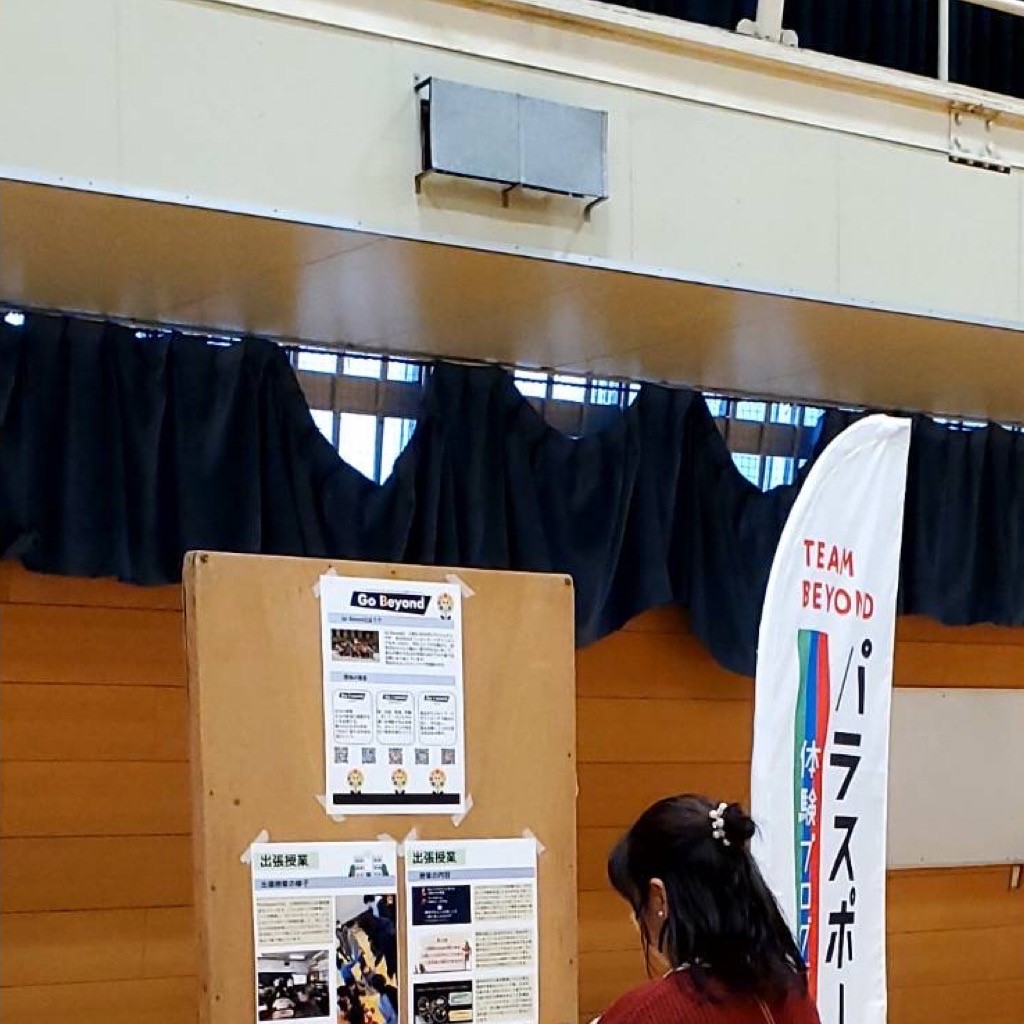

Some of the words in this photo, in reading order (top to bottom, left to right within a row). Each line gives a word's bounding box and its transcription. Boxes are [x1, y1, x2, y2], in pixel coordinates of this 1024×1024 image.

[803, 539, 854, 578] TEAM
[357, 592, 376, 607] Go
[379, 594, 424, 612] Beyond
[801, 580, 875, 620] BEYOND
[260, 853, 309, 869] 出張授業
[412, 850, 457, 865] 出張授業
[798, 739, 821, 980] 体験プログ
